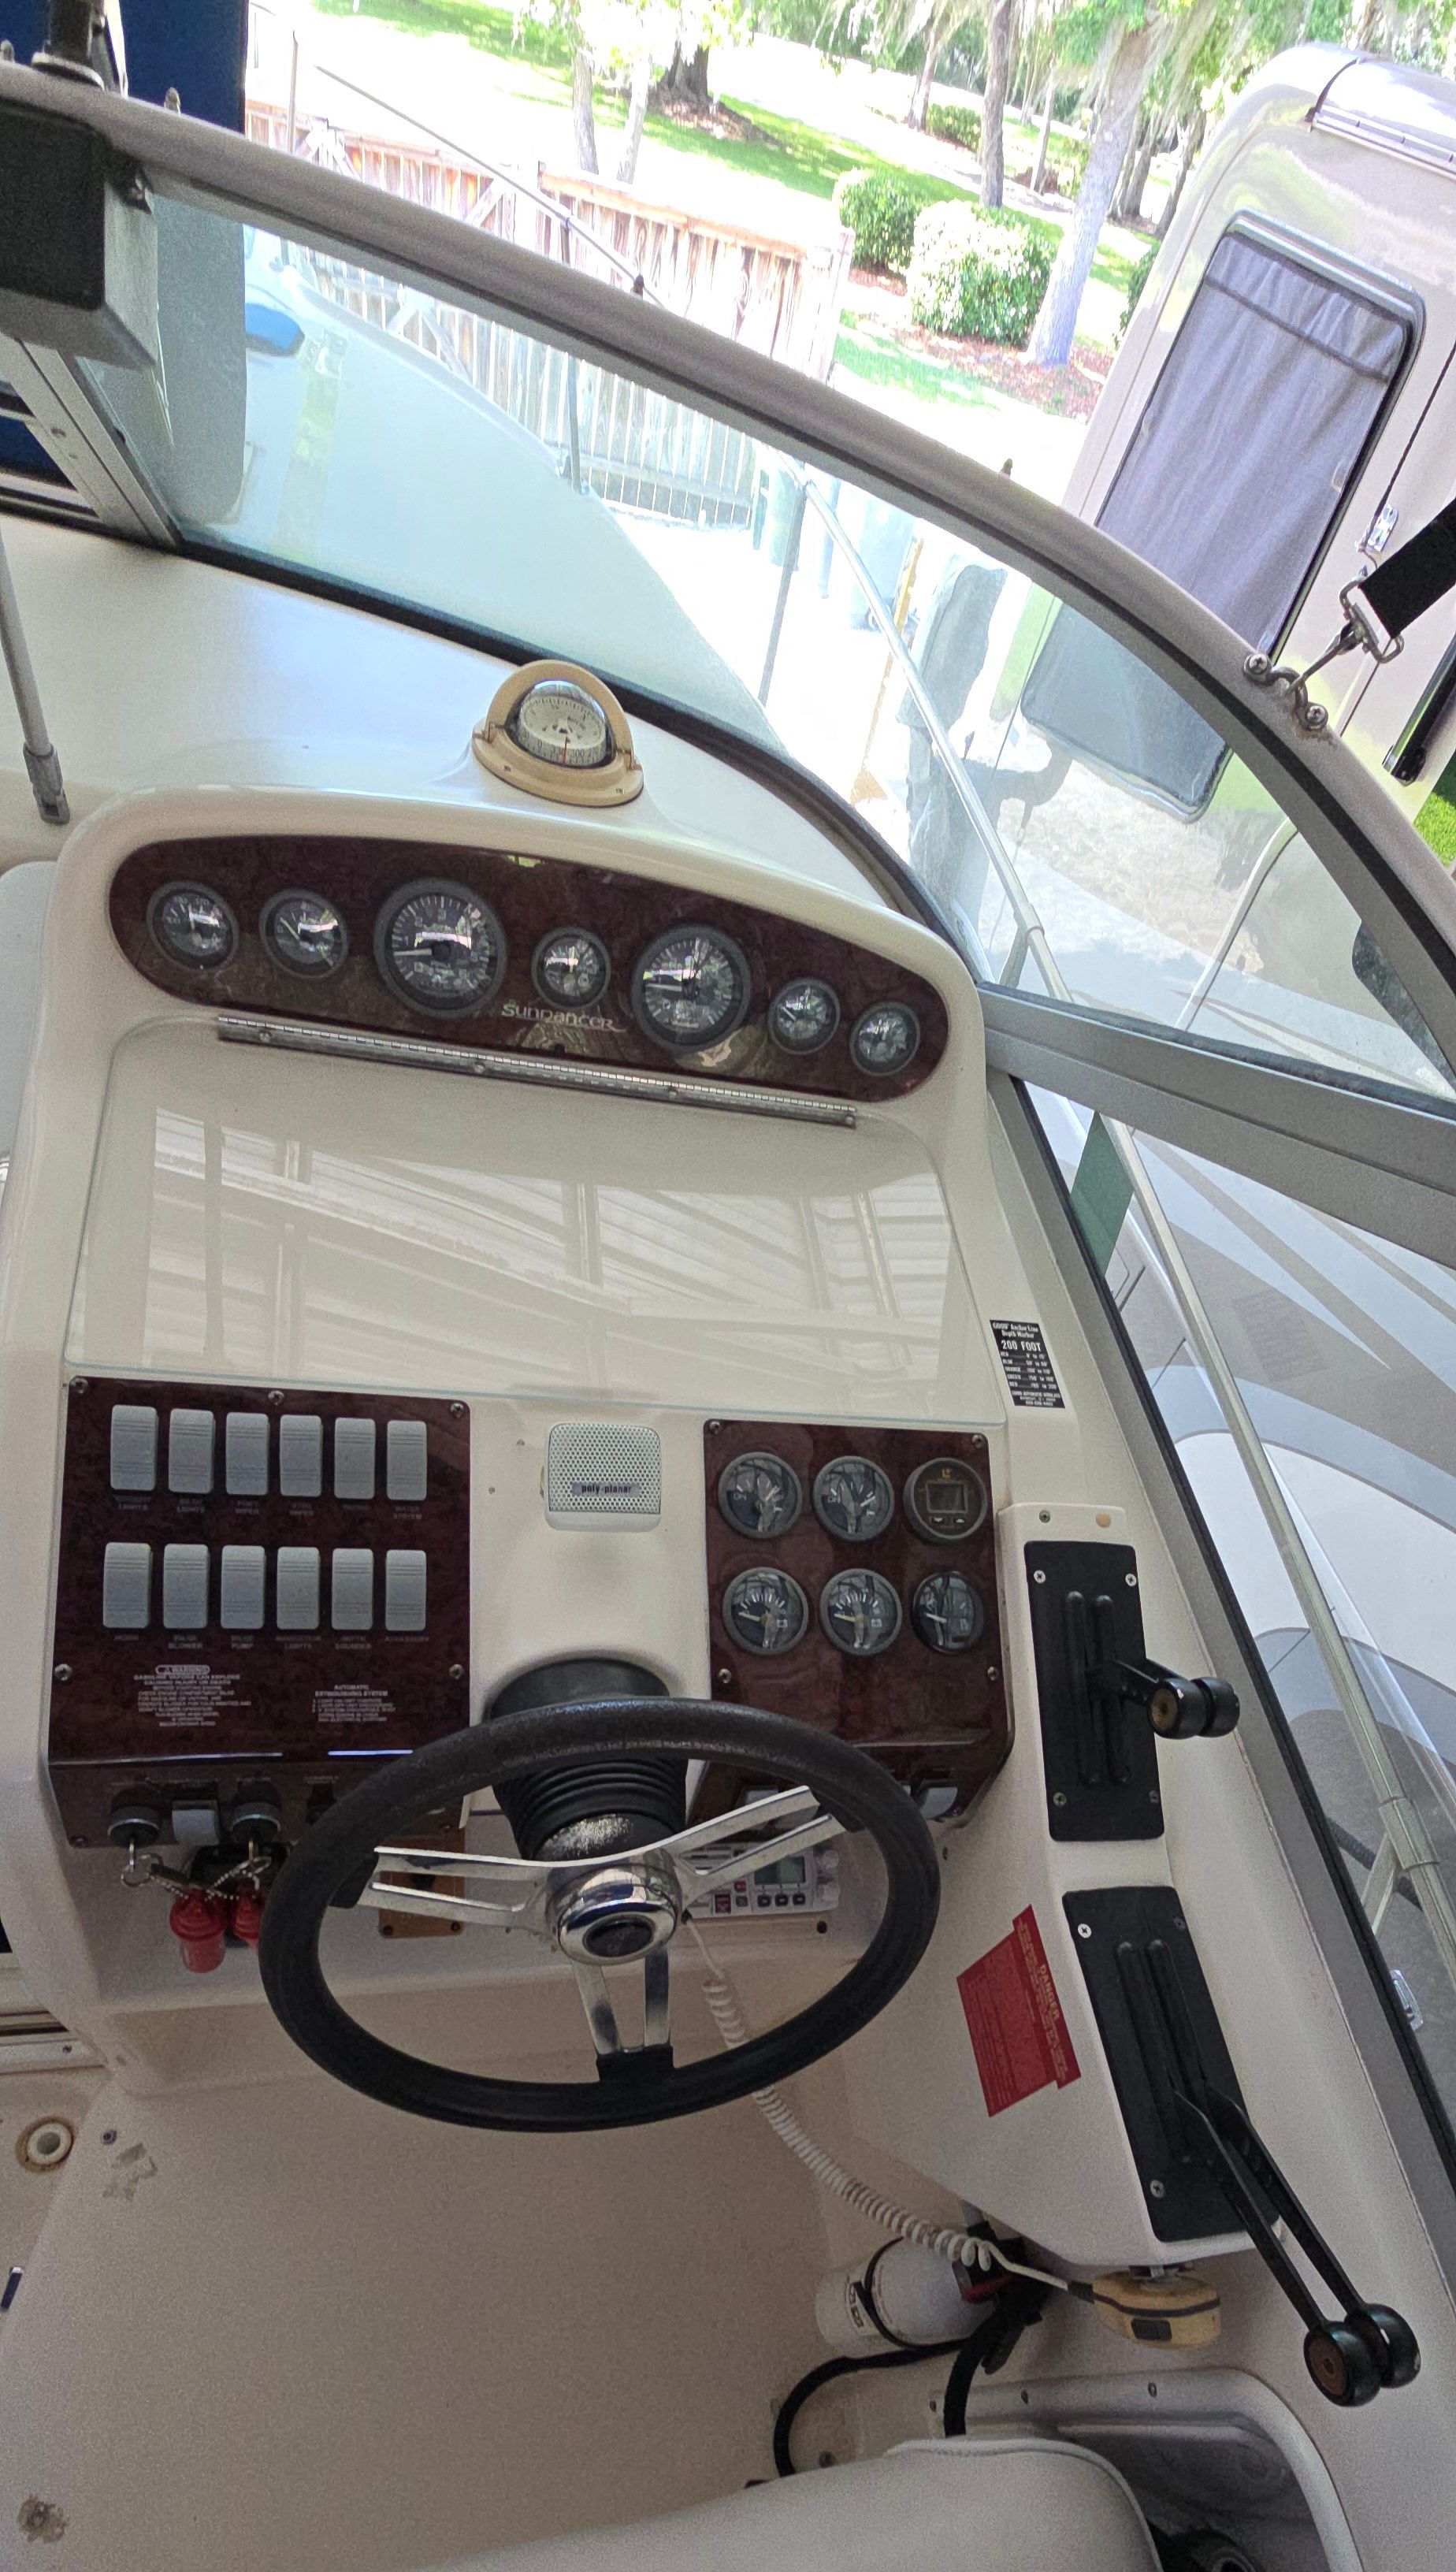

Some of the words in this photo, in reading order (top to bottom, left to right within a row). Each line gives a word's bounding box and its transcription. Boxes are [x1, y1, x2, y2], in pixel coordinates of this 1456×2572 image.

[1001, 1340, 1017, 1351] 200
[1021, 1342, 1041, 1351] FOOT
[1039, 1963, 1059, 2020] DANGER
